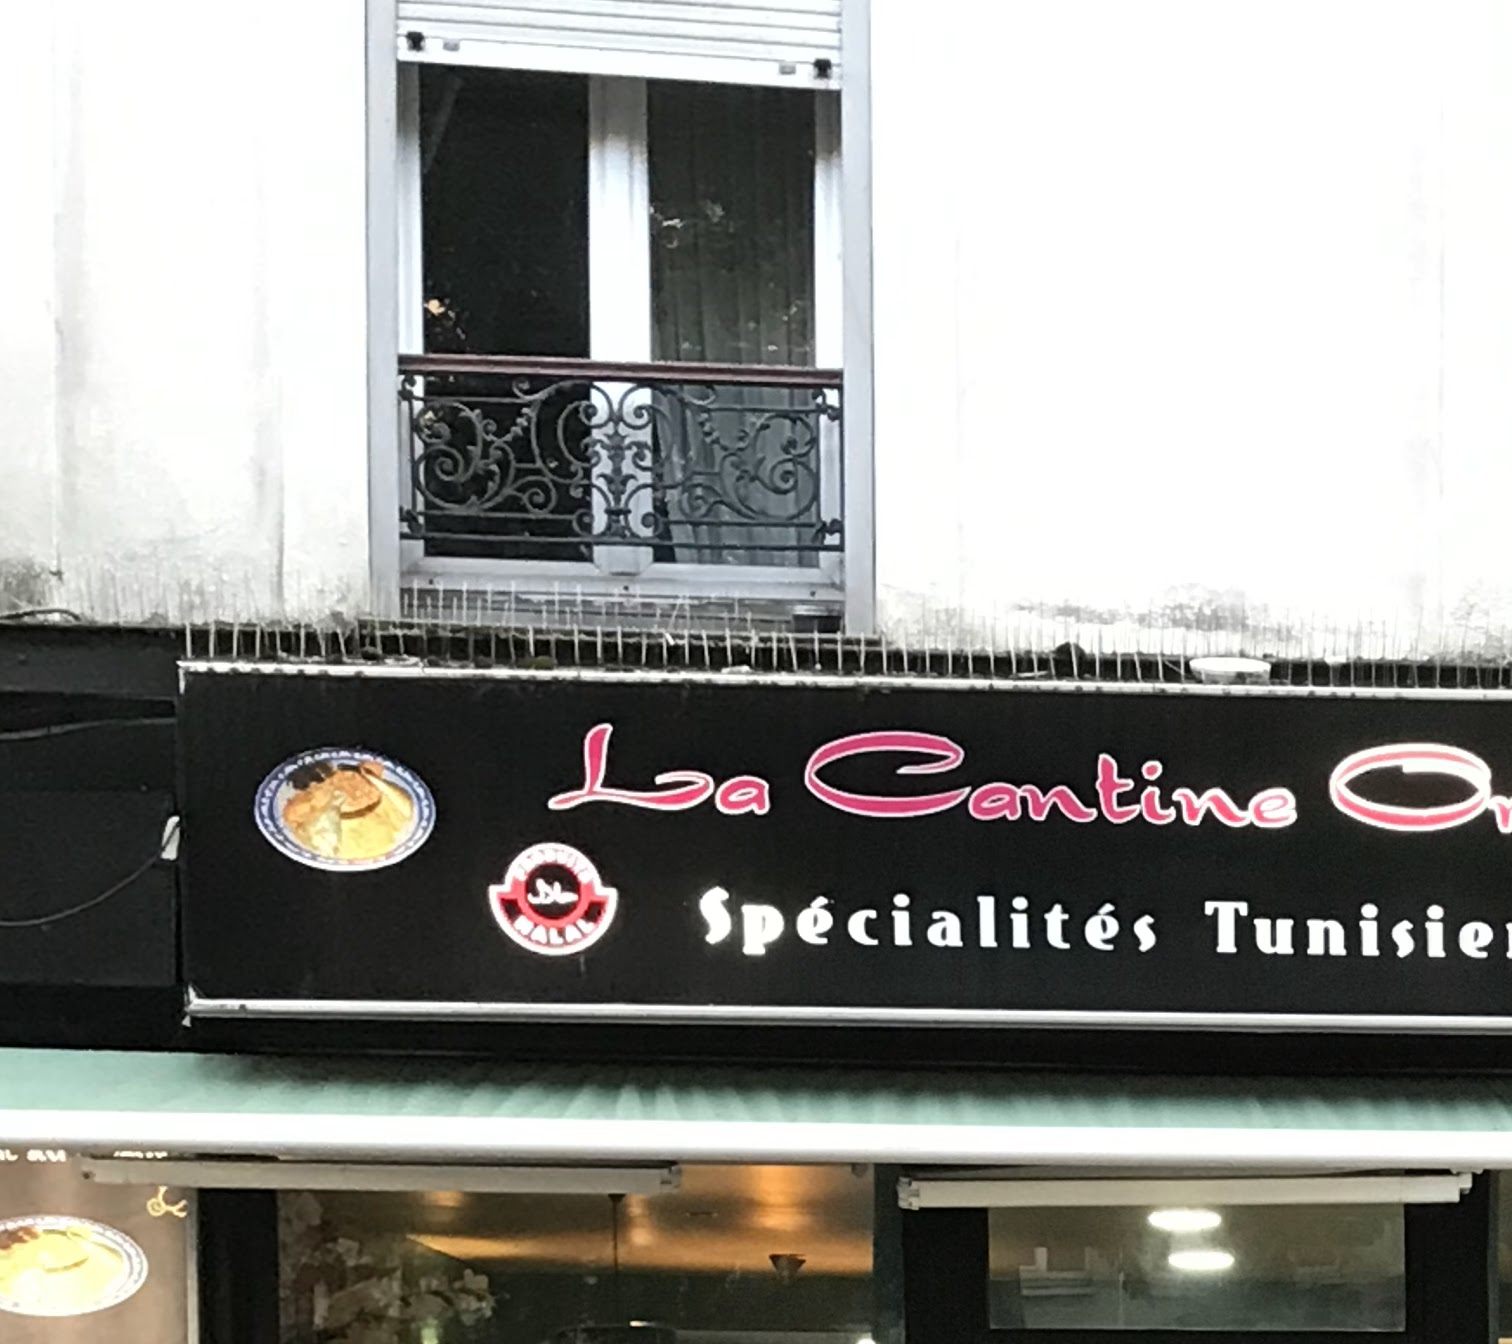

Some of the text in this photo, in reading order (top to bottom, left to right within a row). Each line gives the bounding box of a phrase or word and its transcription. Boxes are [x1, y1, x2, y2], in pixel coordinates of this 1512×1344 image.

[547, 723, 770, 816] La
[804, 729, 1298, 829] Cantine
[513, 915, 597, 946] HALAL
[699, 884, 1158, 957] Spécialités
